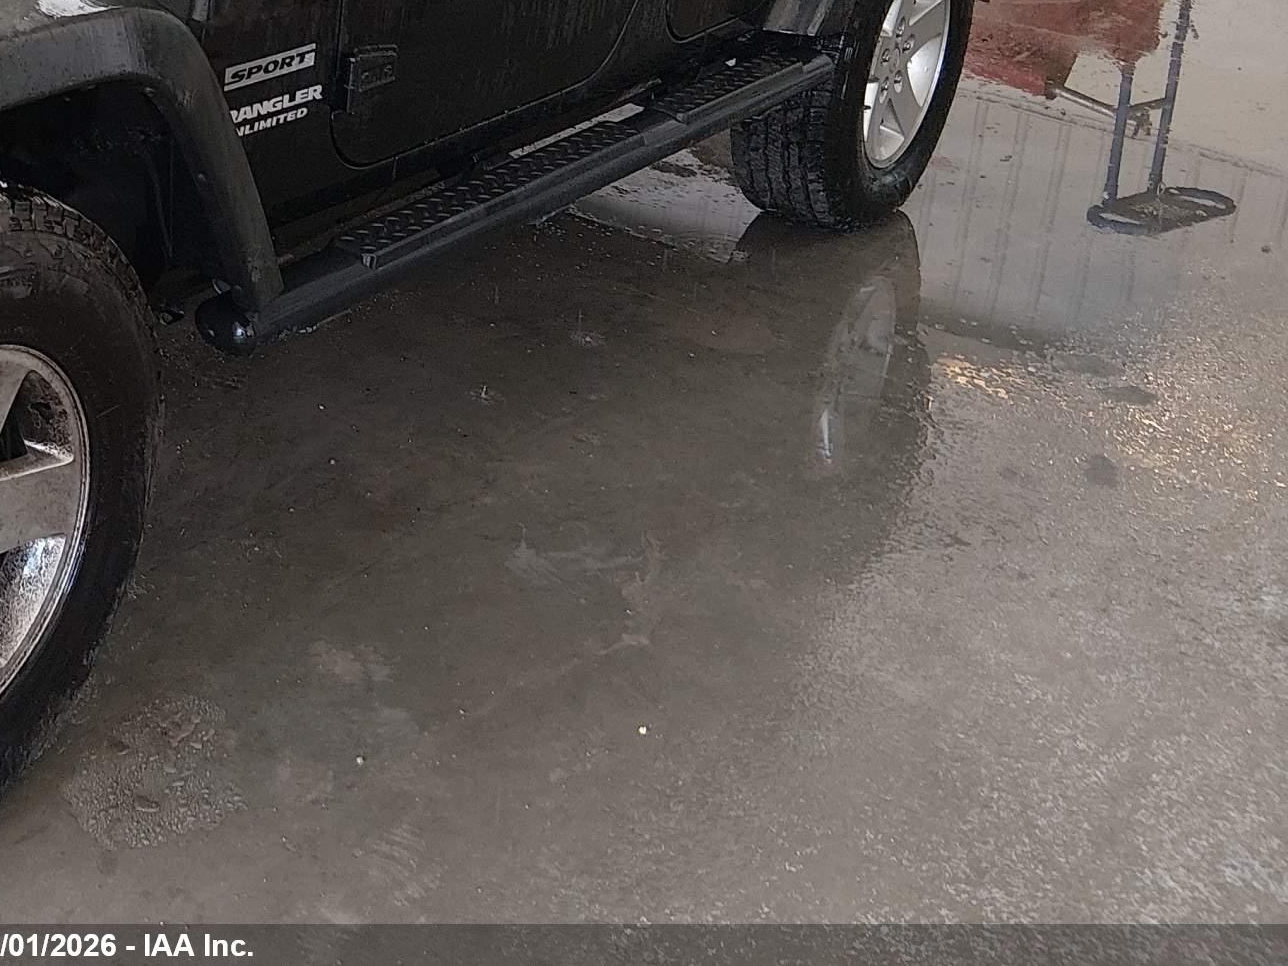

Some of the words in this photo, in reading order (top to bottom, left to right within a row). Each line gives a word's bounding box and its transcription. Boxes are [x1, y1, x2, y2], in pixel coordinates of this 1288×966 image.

[230, 51, 308, 83] SPORT
[230, 84, 323, 124] ANGLER
[236, 107, 308, 137] NLIMITED
